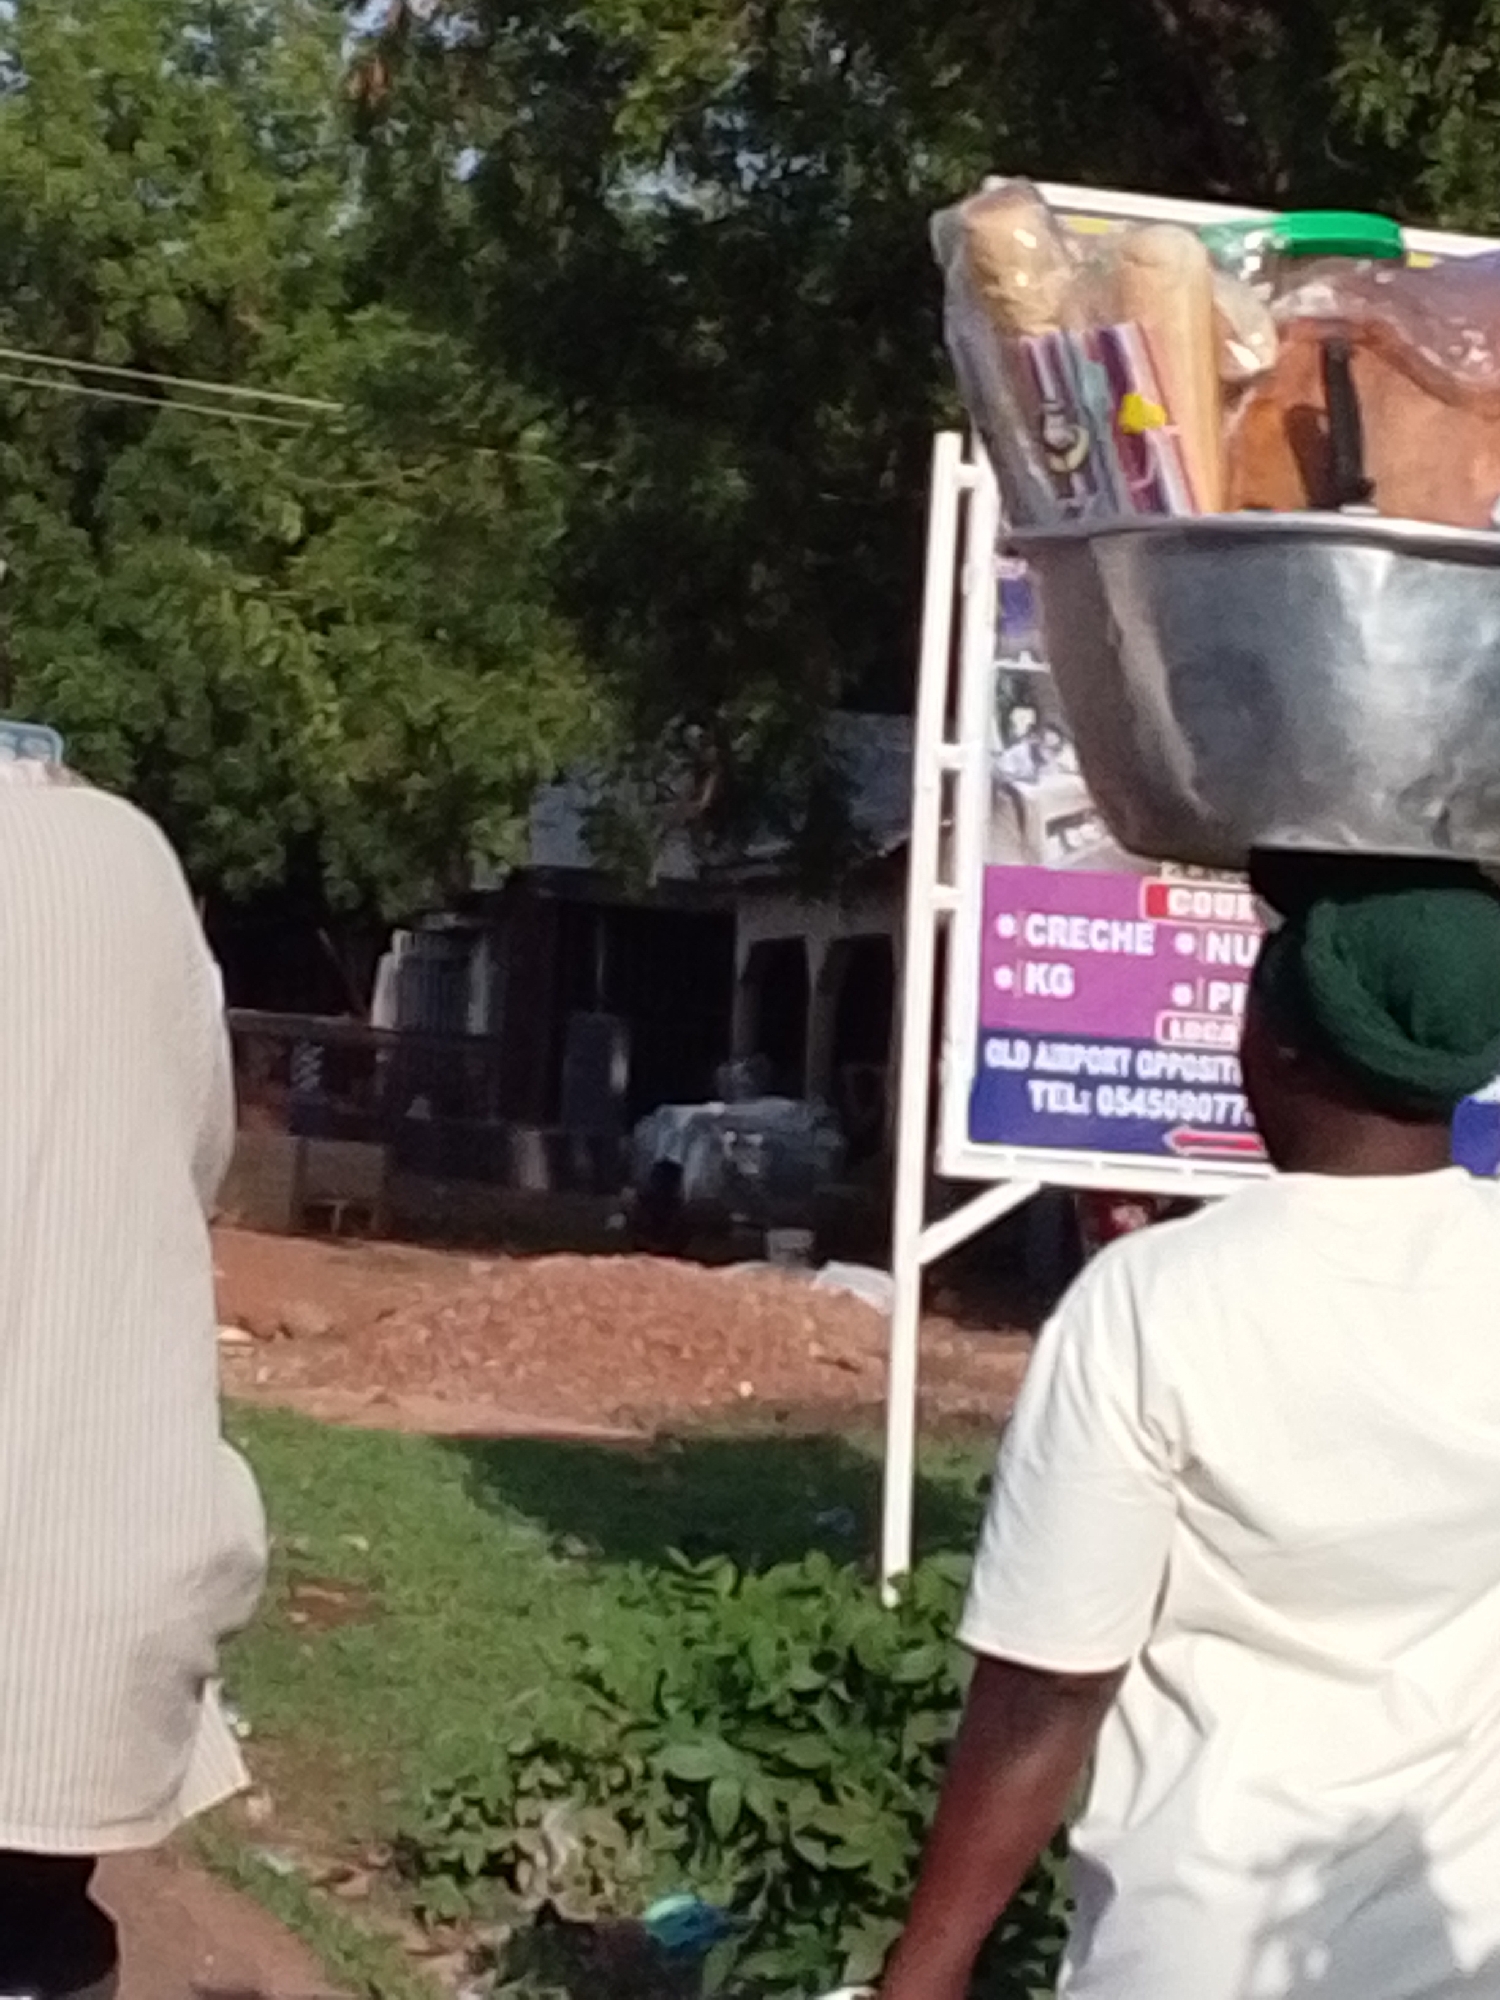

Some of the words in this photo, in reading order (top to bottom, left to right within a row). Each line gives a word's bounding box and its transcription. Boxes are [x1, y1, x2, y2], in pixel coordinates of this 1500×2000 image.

[1024, 913, 1156, 956] CRECHE
[1024, 962, 1075, 997] KG
[984, 1037, 1032, 1071] OLD
[1033, 1039, 1131, 1078] AIRPORT
[1027, 1079, 1093, 1115] TEL:
